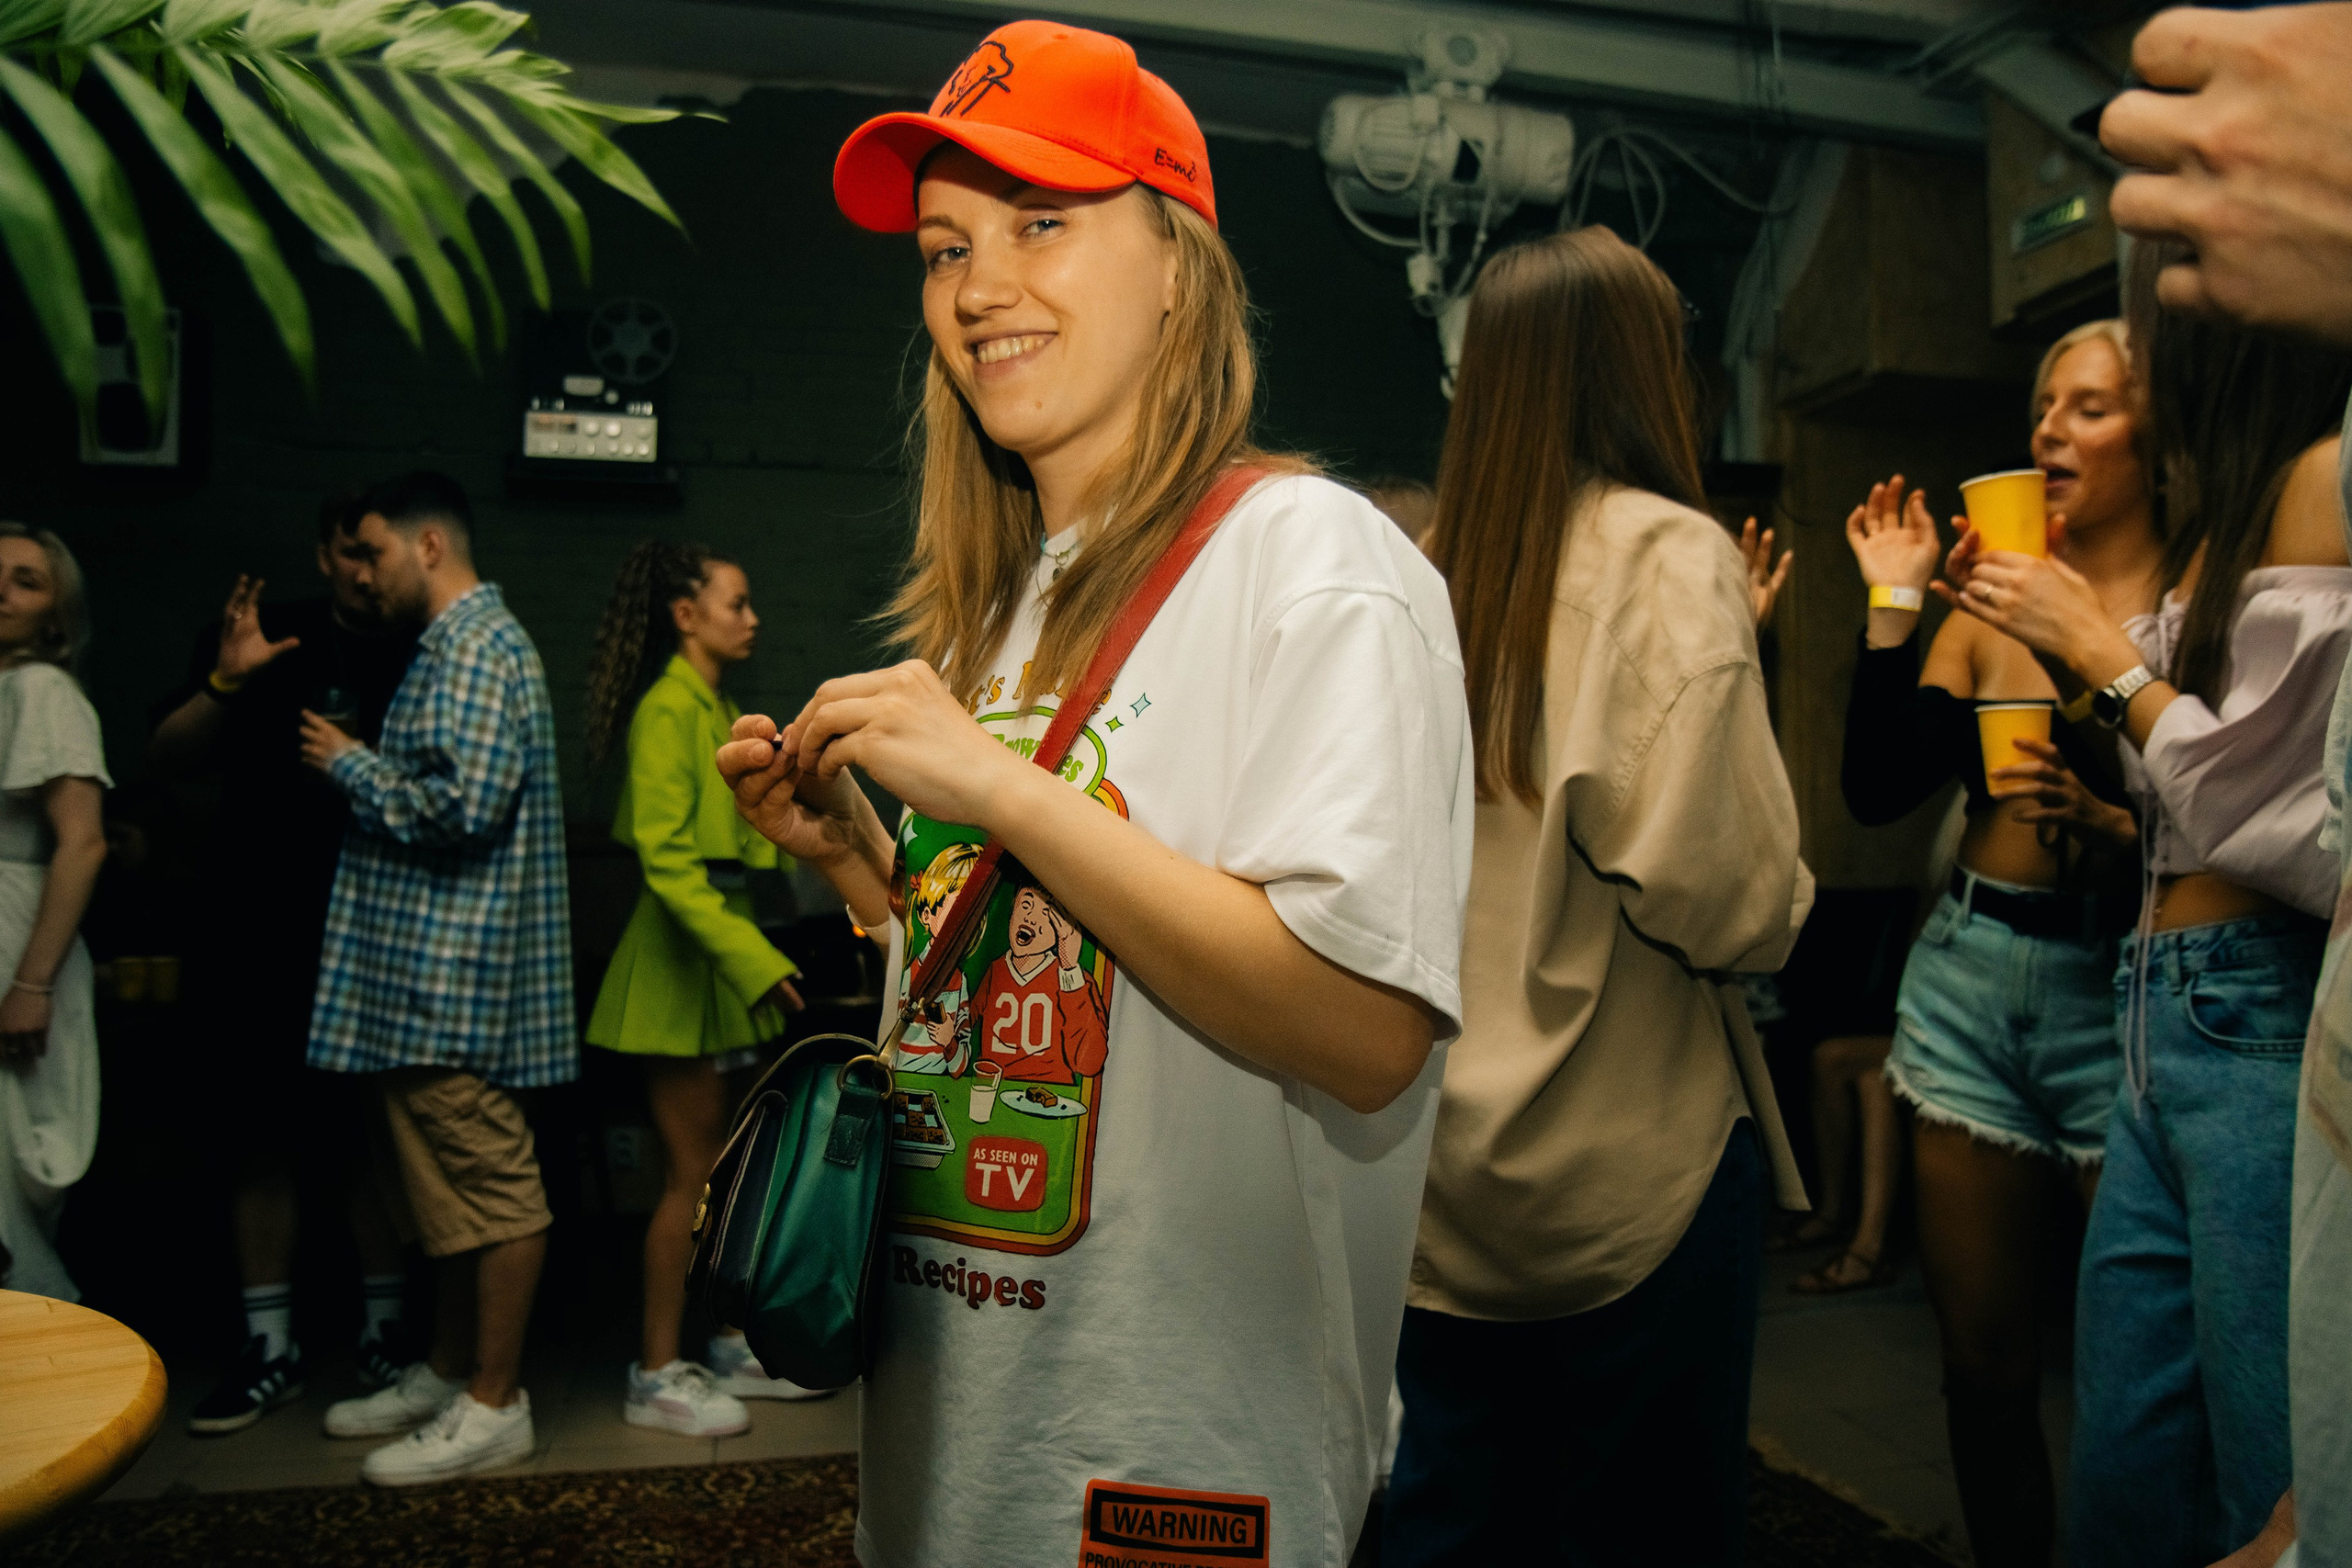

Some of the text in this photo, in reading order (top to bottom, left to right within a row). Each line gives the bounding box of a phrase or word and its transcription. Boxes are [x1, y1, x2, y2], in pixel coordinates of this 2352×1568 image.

[991, 992, 1053, 1056] 20
[974, 1147, 1038, 1167] AS SEEN ON
[975, 1162, 1035, 1201] TV
[892, 1245, 1046, 1310] Recipes
[1113, 1505, 1247, 1545] WARNING
[1085, 1551, 1192, 1568] PROVOC
